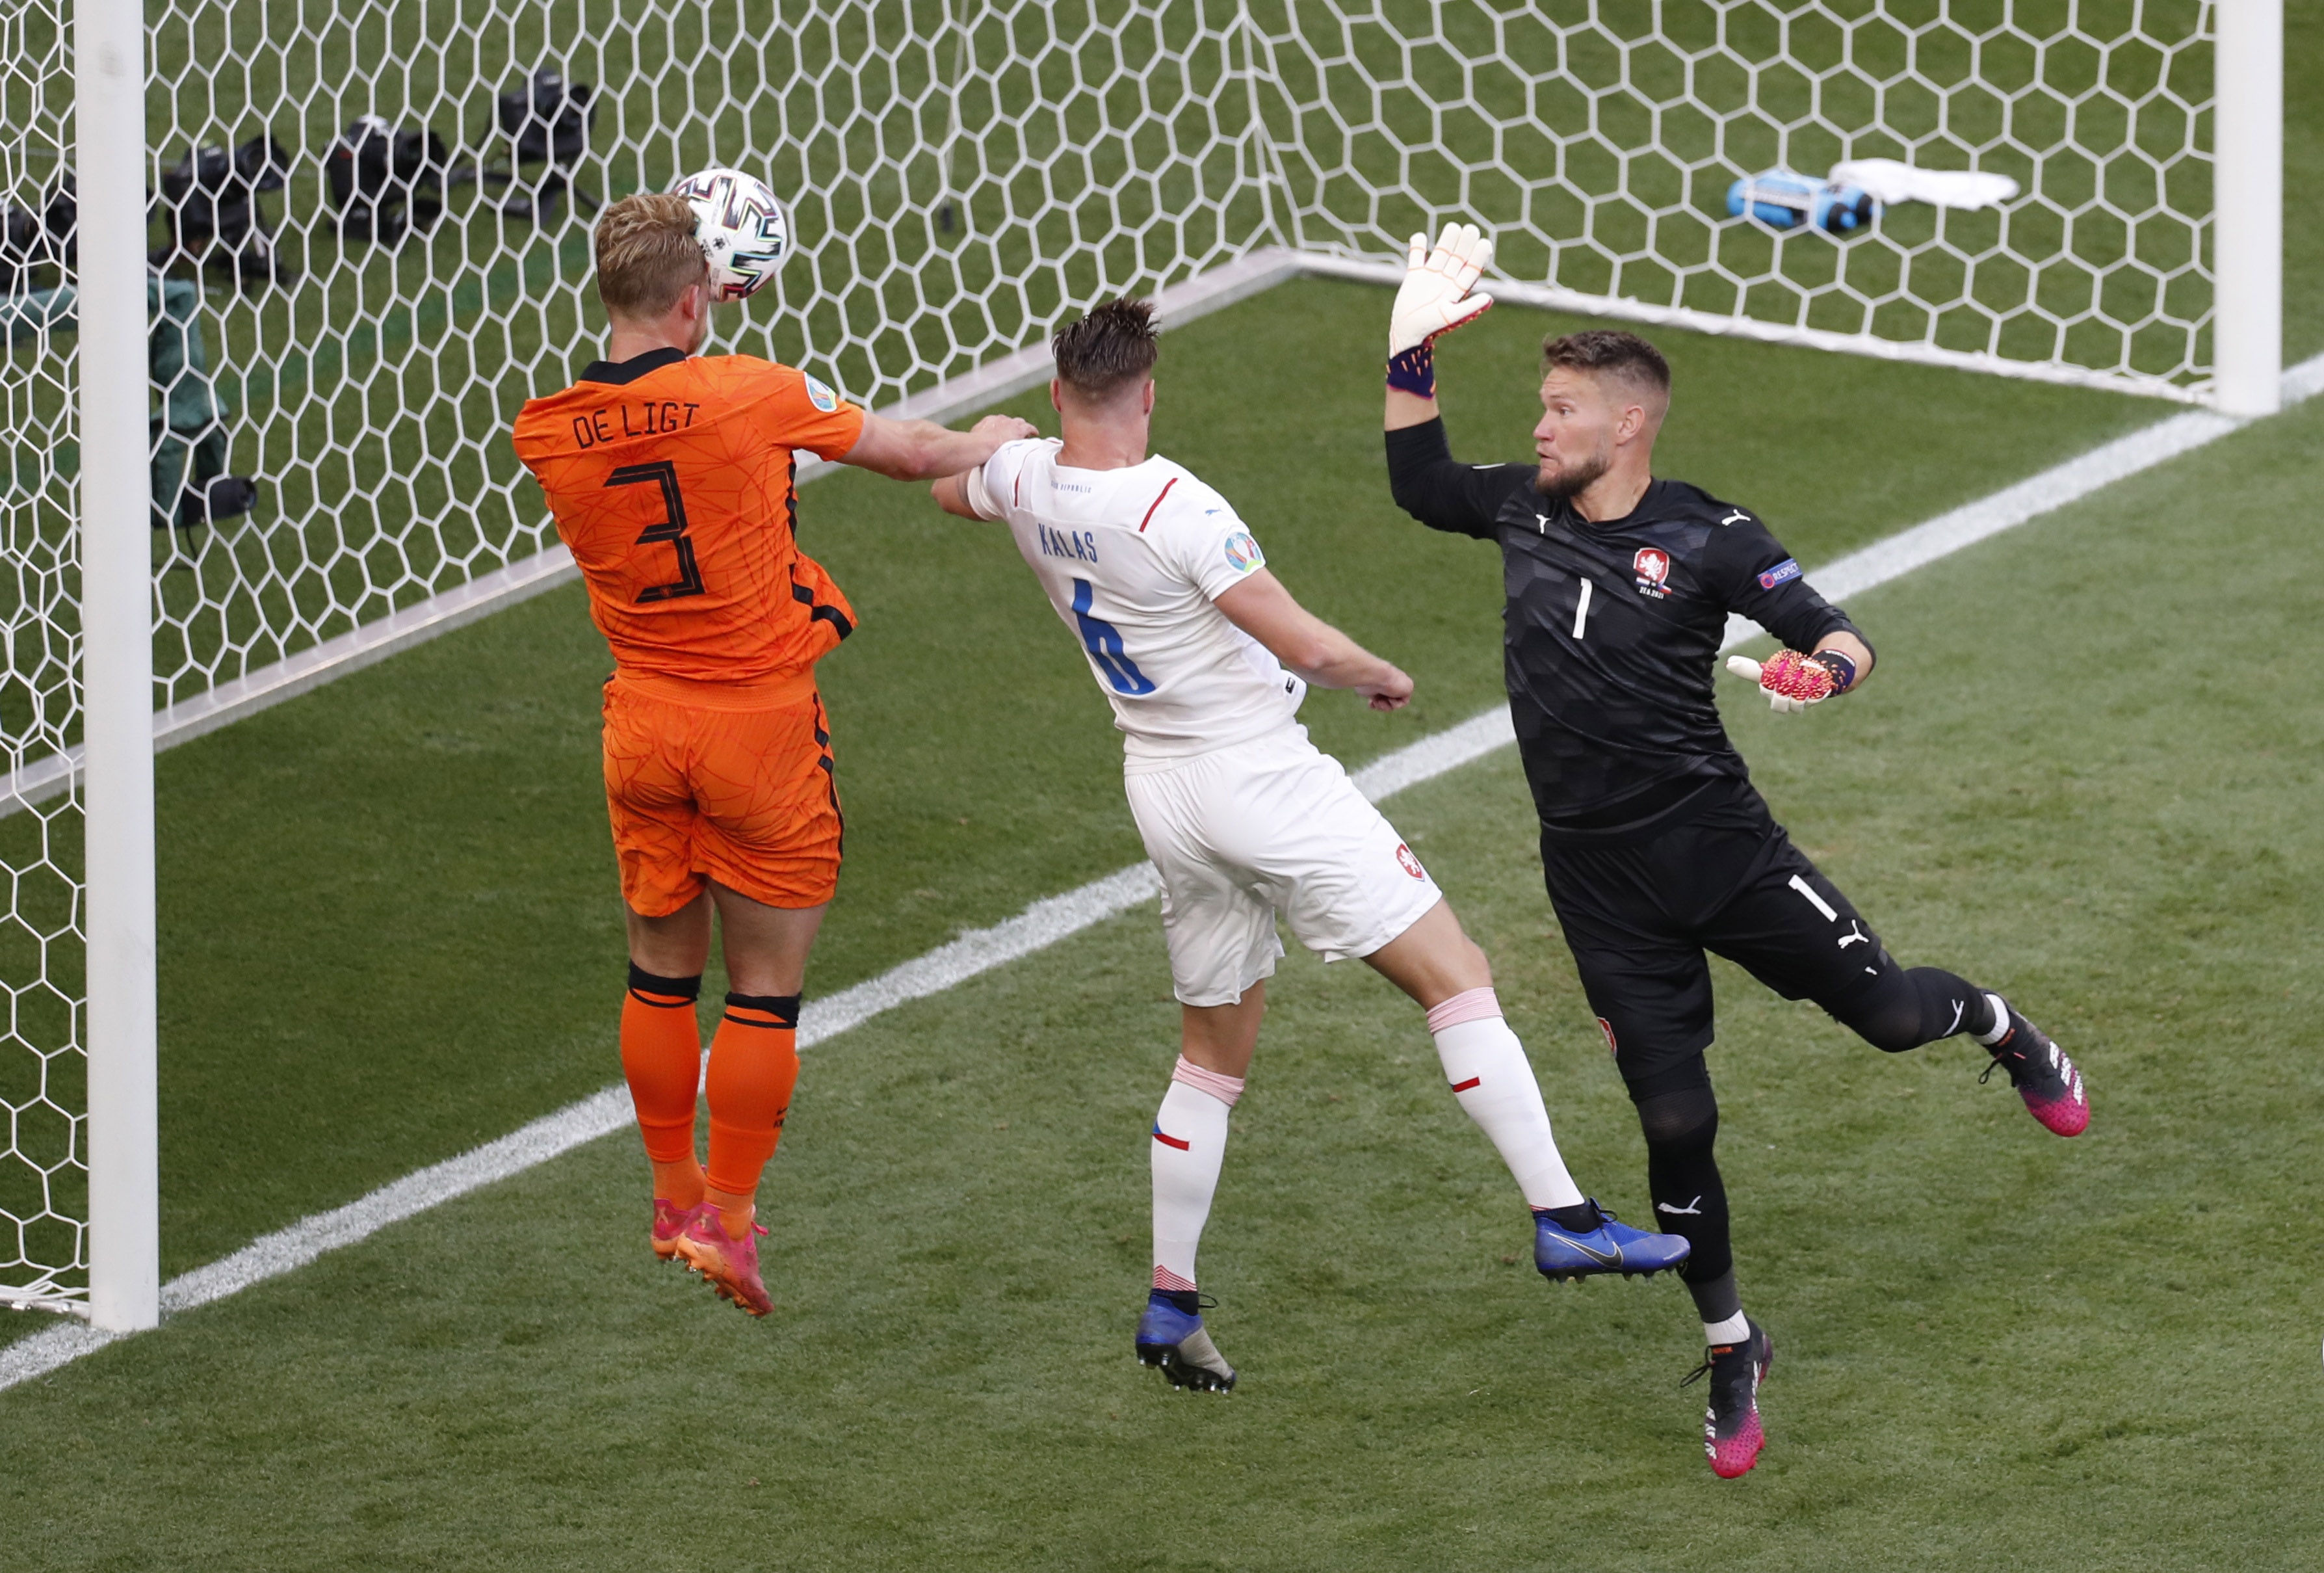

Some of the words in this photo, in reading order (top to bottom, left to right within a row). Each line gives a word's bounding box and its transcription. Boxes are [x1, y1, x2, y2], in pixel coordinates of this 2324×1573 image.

[573, 409, 614, 449] DE
[621, 401, 700, 437] LIGT
[603, 460, 705, 603] 3
[1038, 523, 1097, 563] KALAS
[1771, 562, 1799, 581] RESPECT
[1573, 577, 1592, 639] 1
[1072, 577, 1156, 695] 6
[1788, 874, 1838, 923] 1
